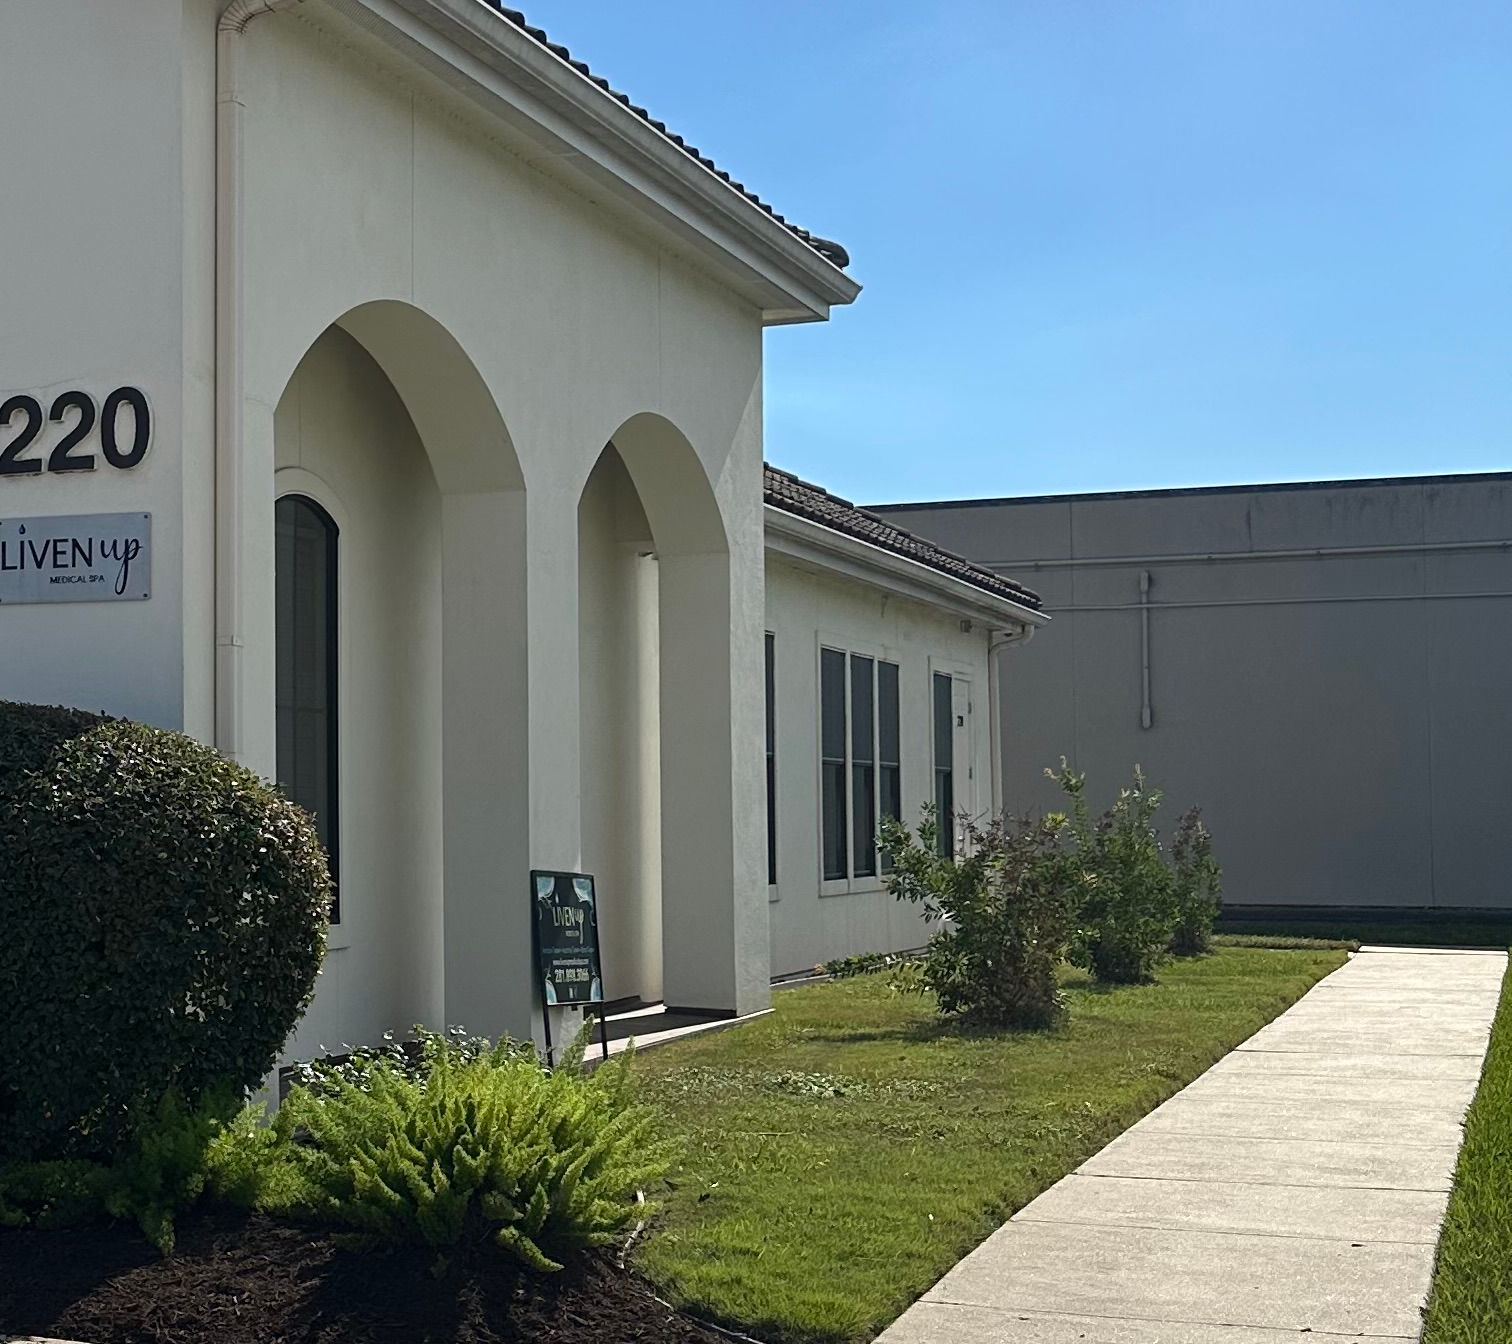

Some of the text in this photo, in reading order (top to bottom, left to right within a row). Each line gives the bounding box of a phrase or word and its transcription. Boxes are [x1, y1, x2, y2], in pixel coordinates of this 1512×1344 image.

[49, 575, 105, 584] MEDICAL SPA
[100, 537, 143, 595] up
